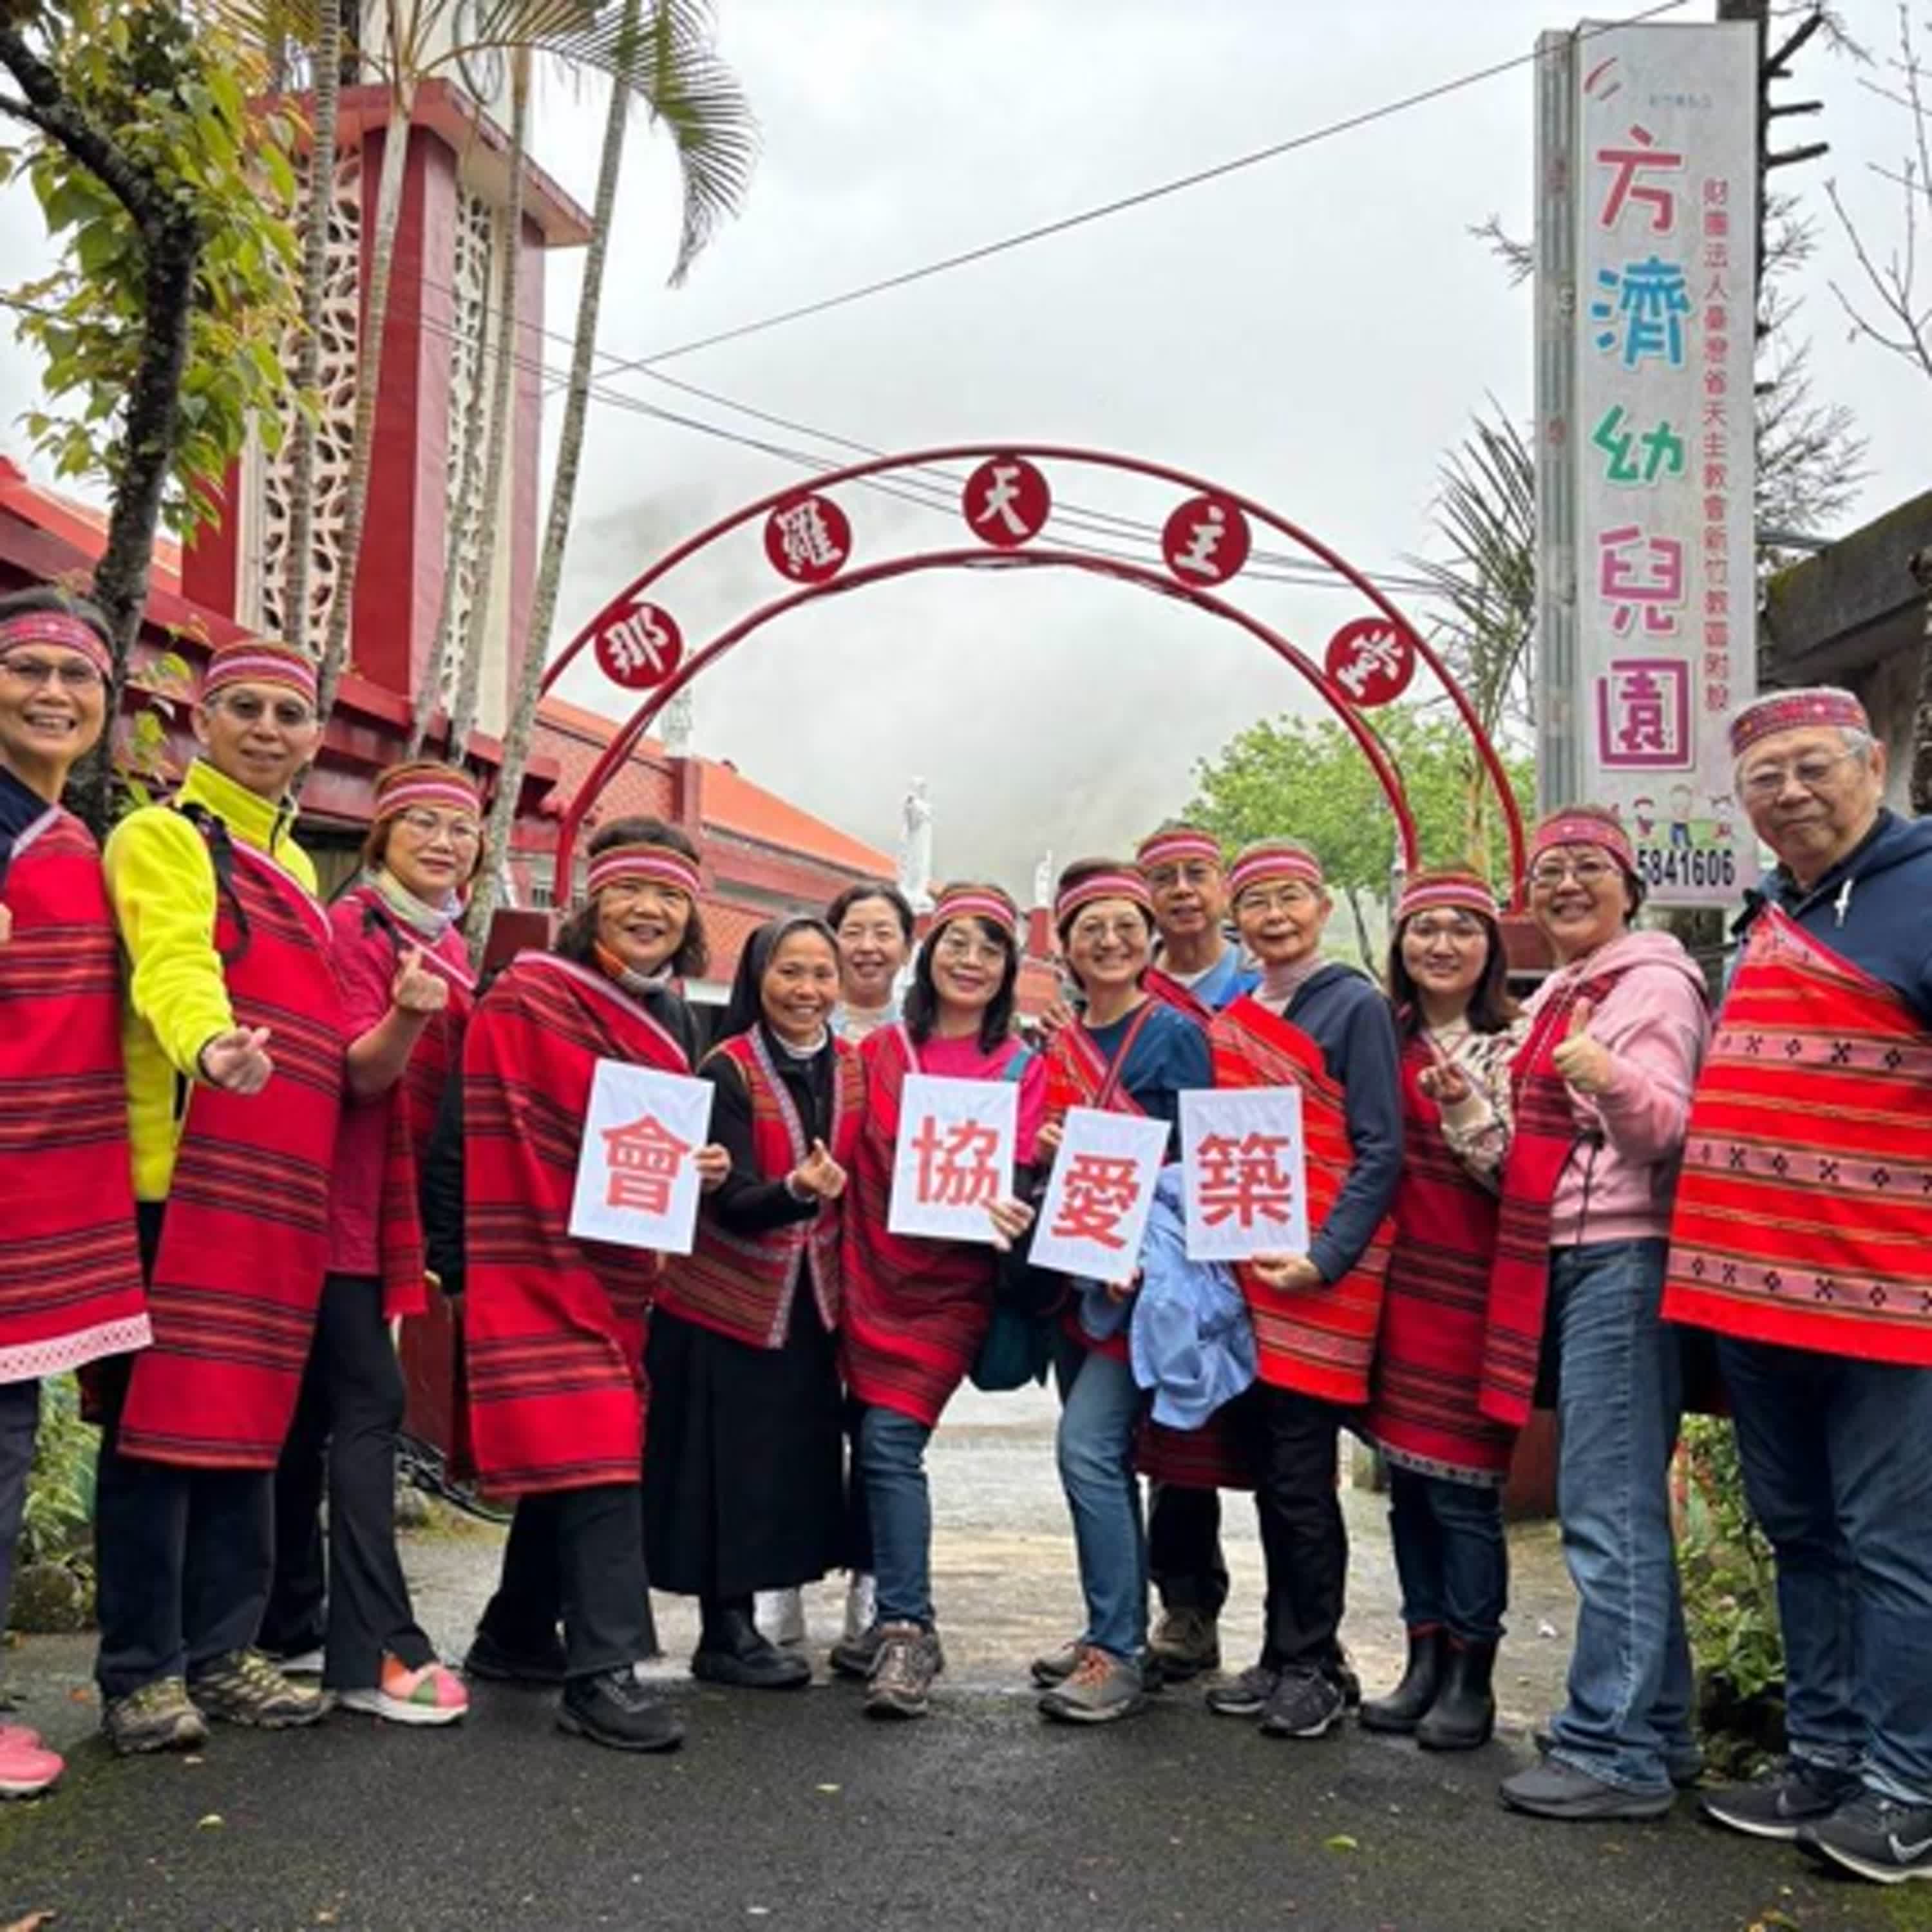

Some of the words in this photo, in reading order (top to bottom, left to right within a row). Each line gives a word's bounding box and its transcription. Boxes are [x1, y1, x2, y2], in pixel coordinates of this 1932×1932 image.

[1591, 126, 1689, 765] 方濟幼兒園
[601, 1115, 688, 1215] 會
[912, 1115, 1000, 1207] 協
[1052, 1154, 1140, 1249] 愛
[1197, 1133, 1292, 1227] 築
